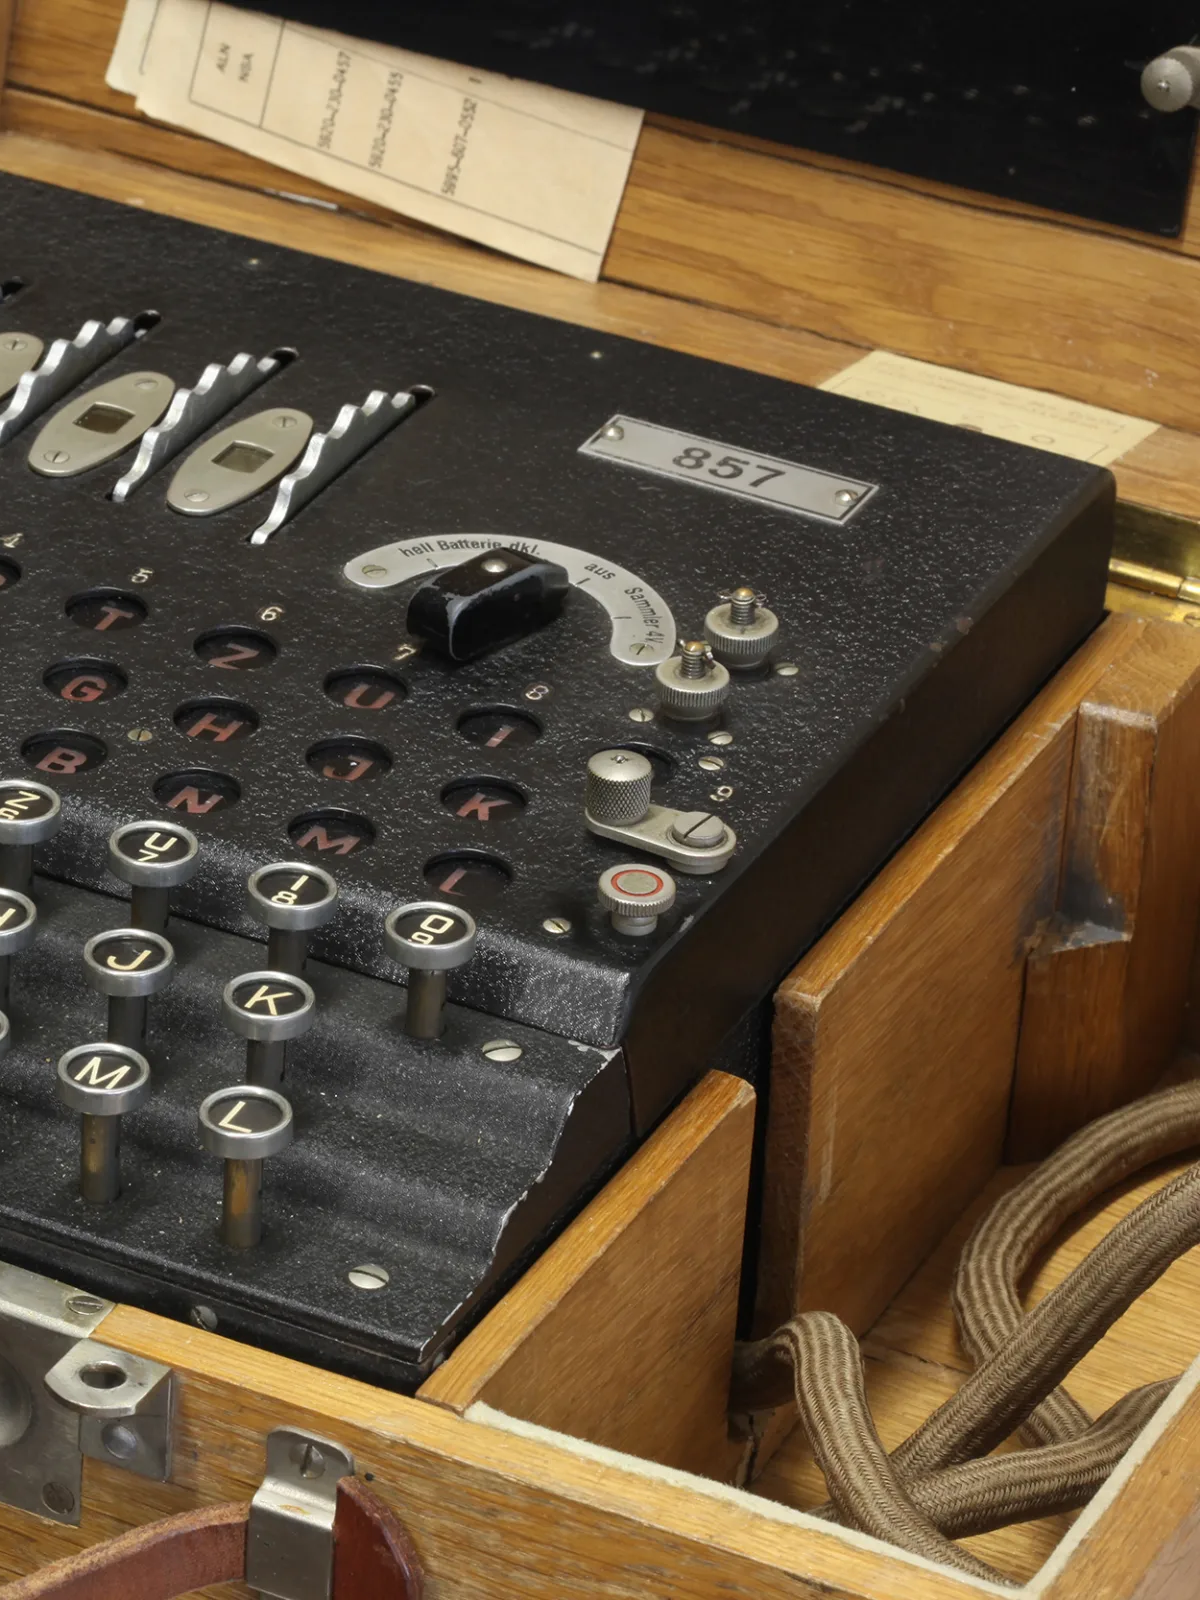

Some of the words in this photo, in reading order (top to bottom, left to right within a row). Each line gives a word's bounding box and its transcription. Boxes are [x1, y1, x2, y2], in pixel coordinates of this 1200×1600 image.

[672, 446, 786, 488] 857
[398, 541, 435, 558] hell
[436, 538, 502, 551] Batterie
[509, 540, 541, 556] dkl.
[131, 567, 153, 583] 5
[583, 563, 616, 580] aus
[94, 605, 135, 631] T
[261, 606, 284, 621] 6
[623, 586, 663, 629] Sammler
[208, 642, 260, 671] Z
[60, 674, 109, 703] G
[344, 683, 396, 709] U
[524, 685, 550, 701] 8
[186, 712, 244, 742] H
[35, 746, 88, 774] B
[322, 755, 374, 781] J
[4, 790, 40, 810] Z
[166, 785, 224, 814] N
[456, 791, 512, 822] K
[710, 785, 733, 802] 9
[144, 832, 179, 852] U
[296, 825, 361, 855] M
[290, 874, 310, 891] I
[438, 867, 468, 898] L
[271, 890, 298, 905] 8
[419, 914, 454, 934] O
[106, 949, 152, 971] J
[244, 984, 294, 1016] K
[74, 1056, 132, 1090] M
[218, 1100, 253, 1133] L
